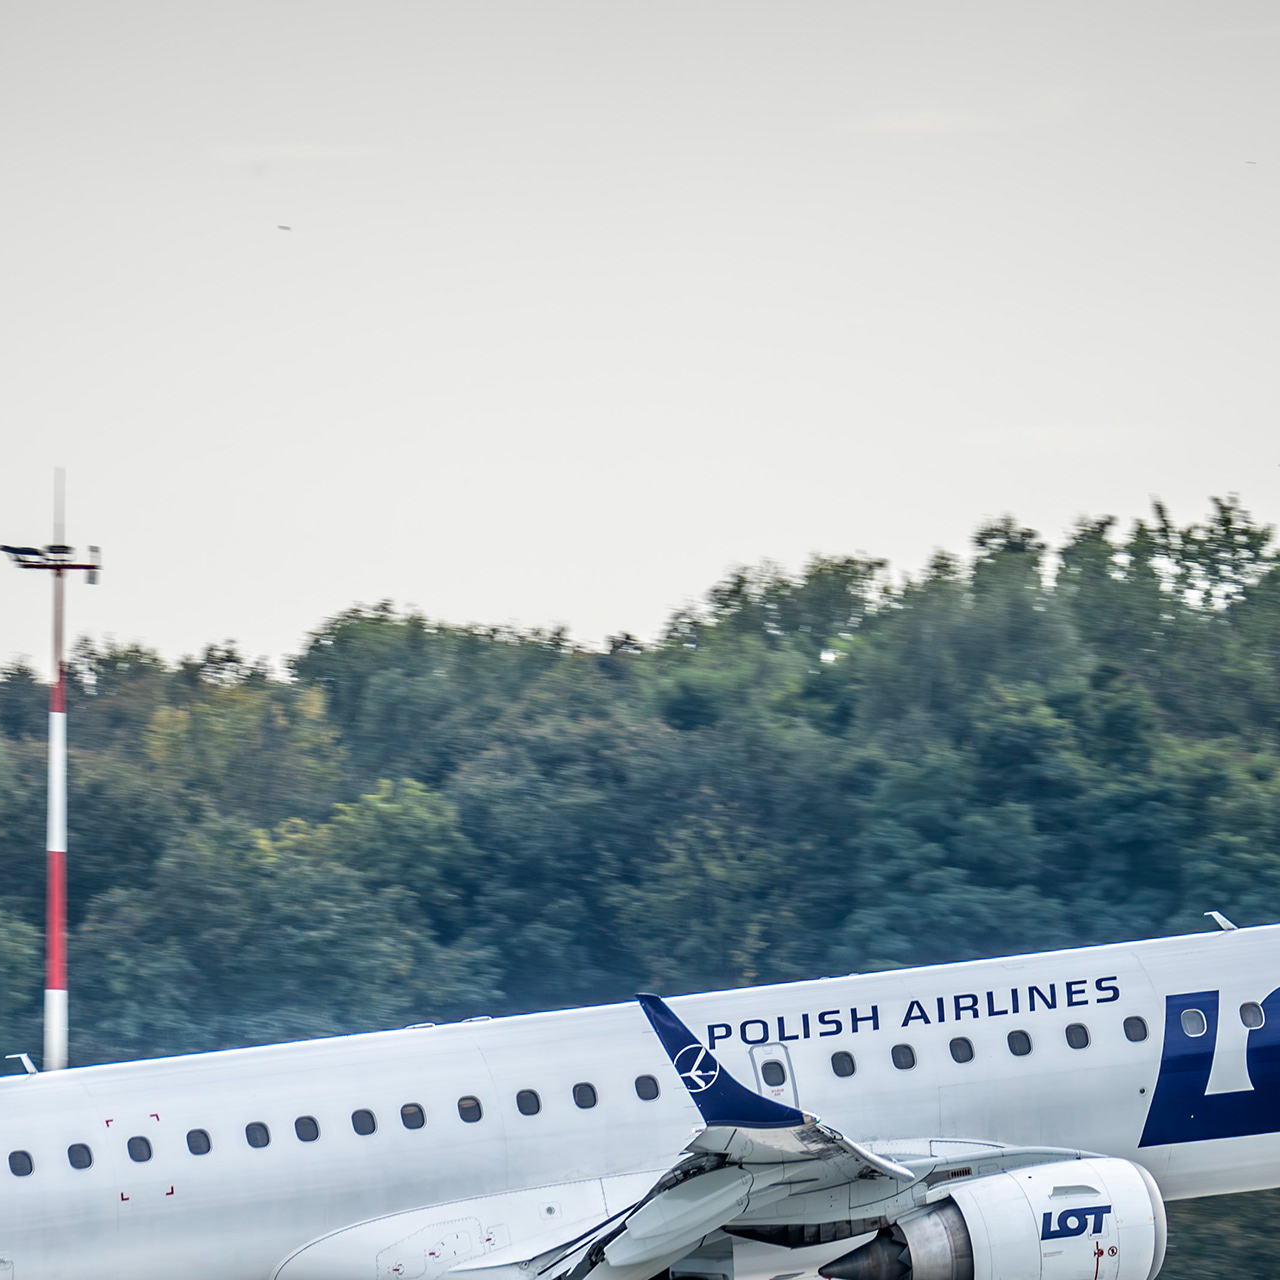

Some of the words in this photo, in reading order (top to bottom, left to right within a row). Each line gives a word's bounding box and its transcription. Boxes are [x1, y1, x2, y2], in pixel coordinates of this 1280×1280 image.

[707, 1005, 880, 1050] POLISH
[901, 976, 1120, 1027] AIRLINES
[1040, 1204, 1112, 1241] LOT
